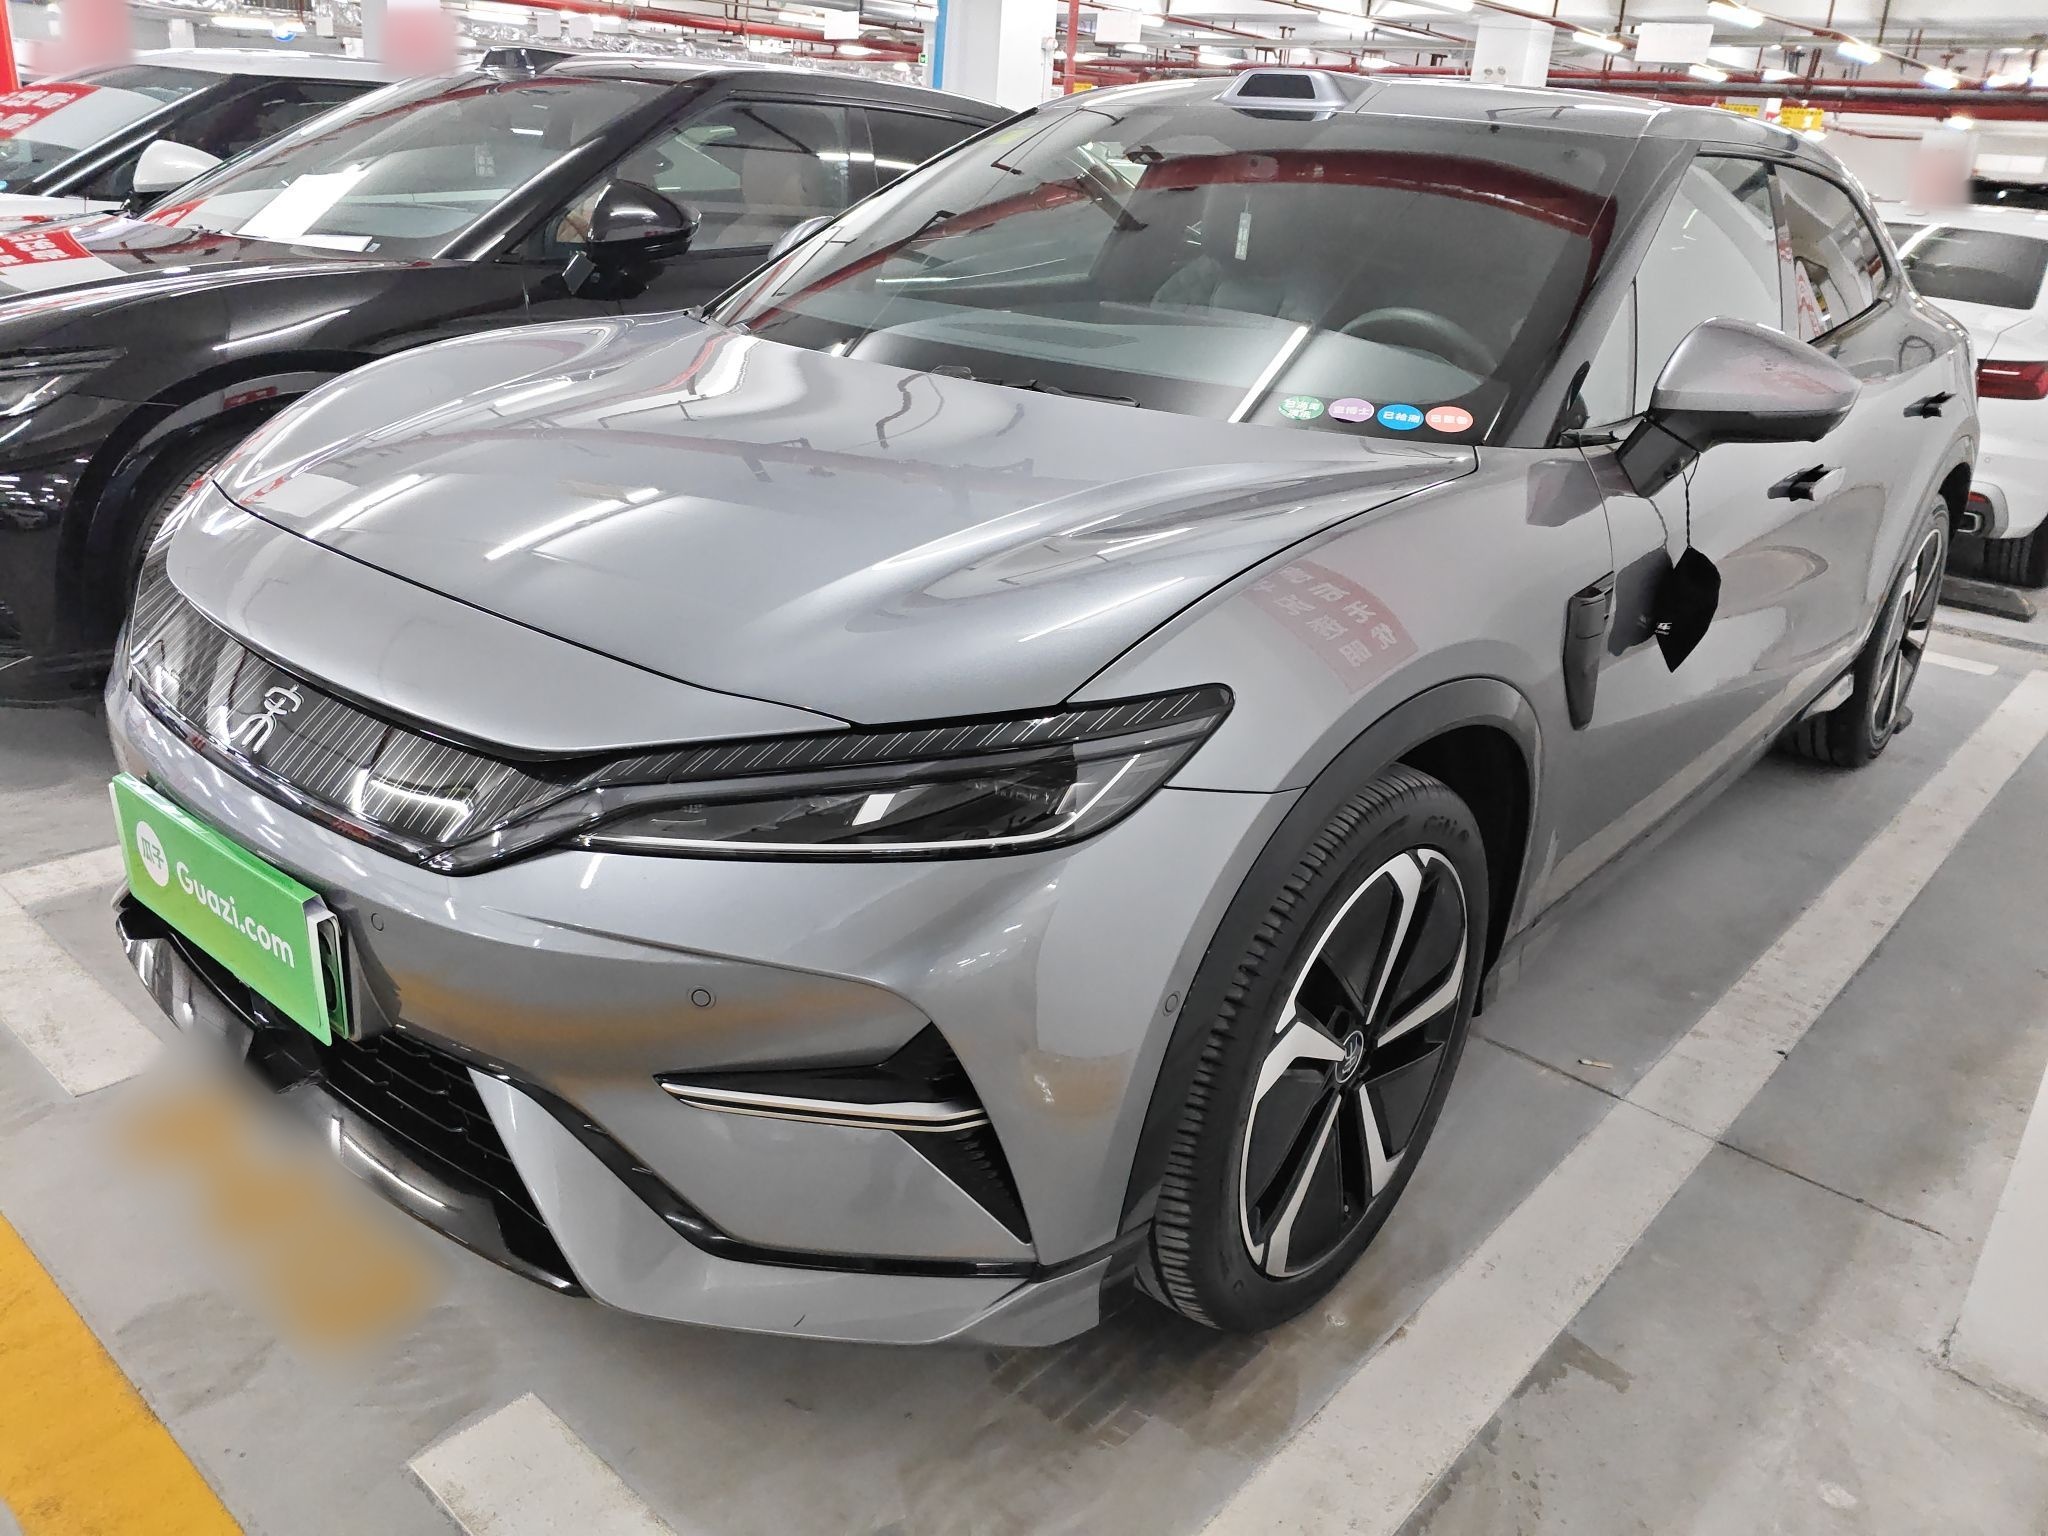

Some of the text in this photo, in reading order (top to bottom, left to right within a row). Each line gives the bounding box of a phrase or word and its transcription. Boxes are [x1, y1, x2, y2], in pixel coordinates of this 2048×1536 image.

[1382, 411, 1421, 424] 已检测
[141, 836, 165, 871] 瓜子
[176, 861, 295, 969] Guazi.com
